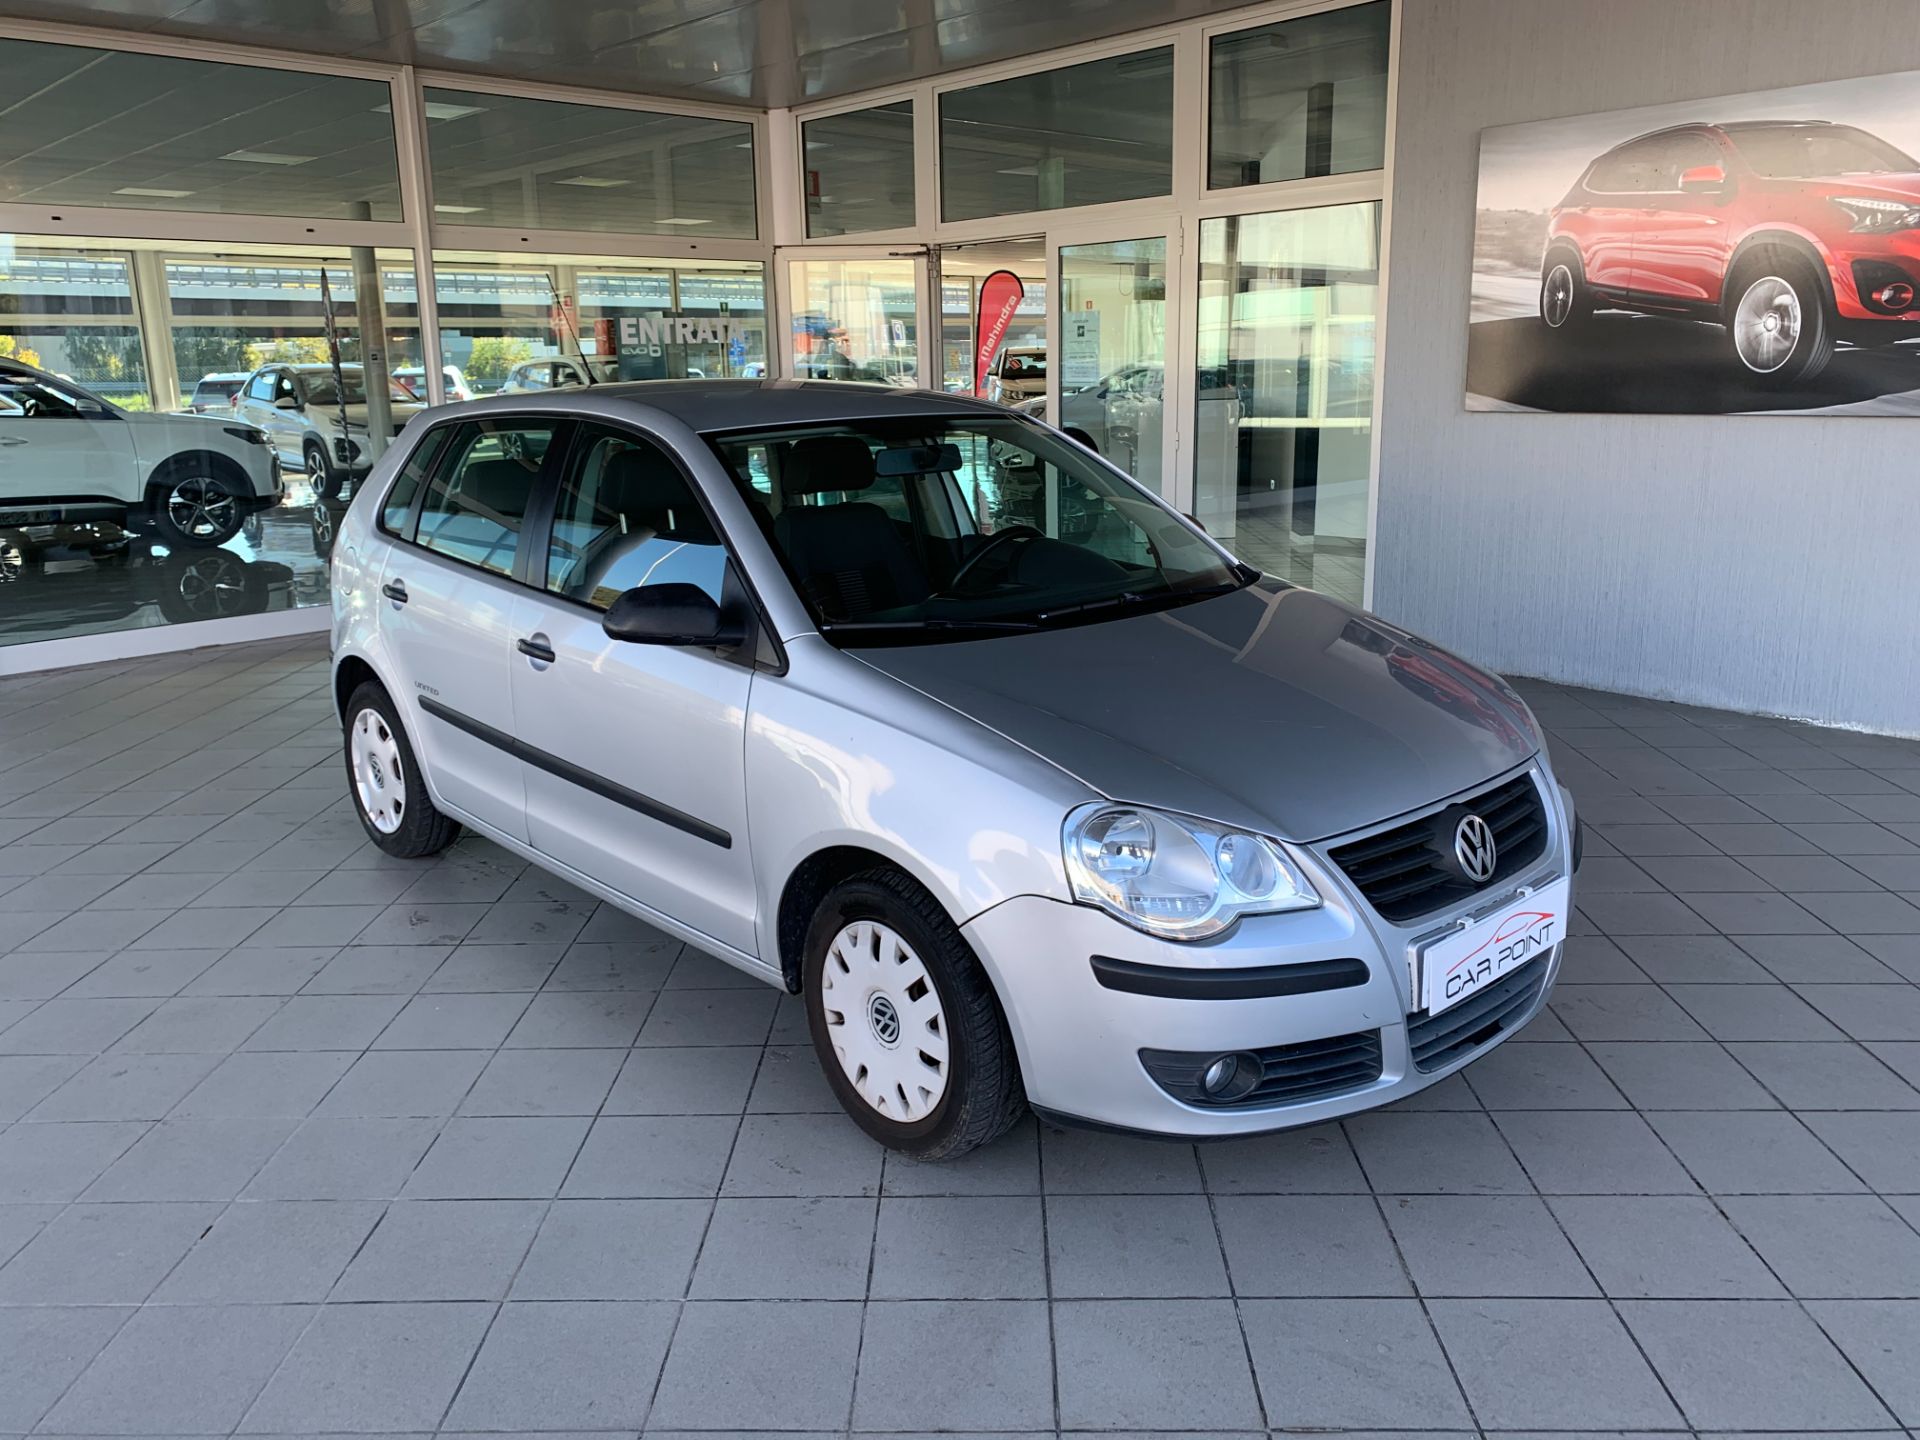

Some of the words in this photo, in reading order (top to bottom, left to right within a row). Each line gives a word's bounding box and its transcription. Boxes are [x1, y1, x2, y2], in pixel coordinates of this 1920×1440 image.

[620, 317, 746, 344] ENTRATA
[980, 294, 1017, 361] Mahindra
[414, 680, 439, 695] UNITED
[1446, 957, 1492, 999] CAR
[1498, 921, 1555, 970] POINT
